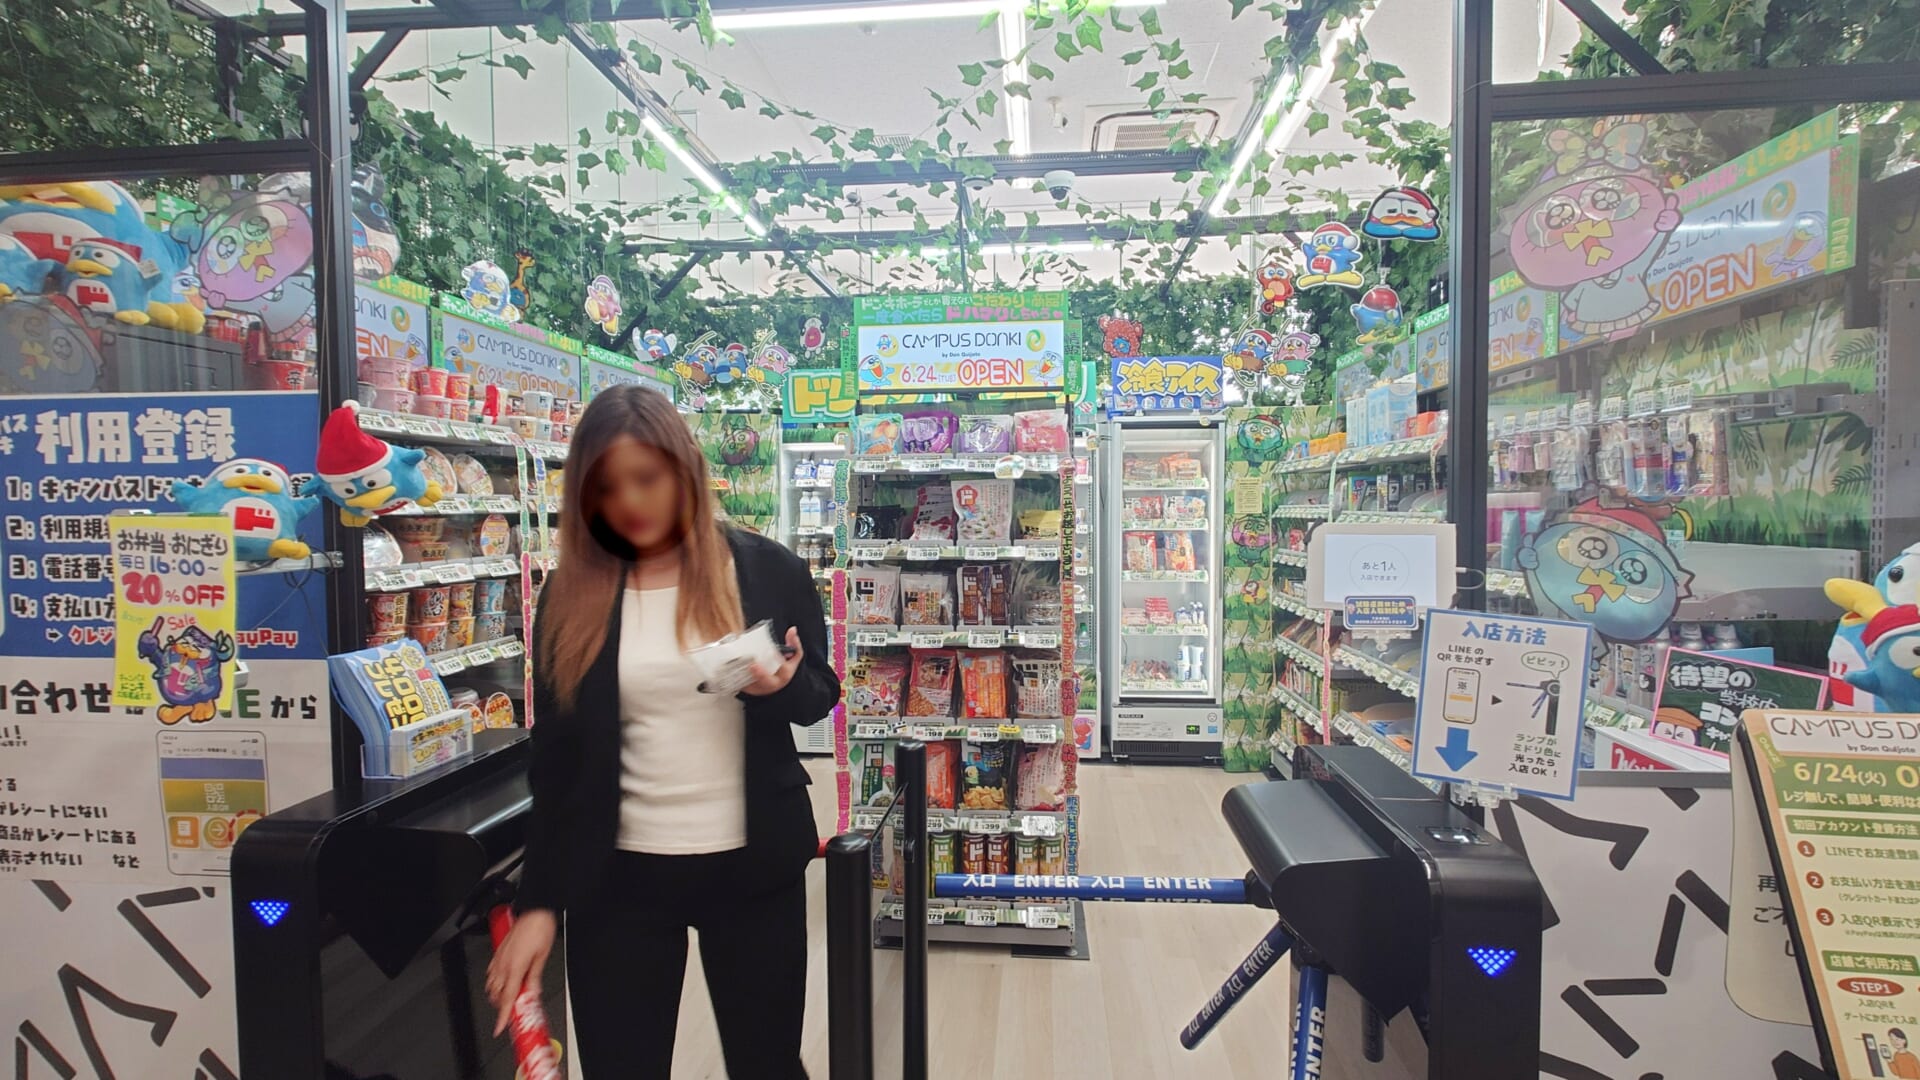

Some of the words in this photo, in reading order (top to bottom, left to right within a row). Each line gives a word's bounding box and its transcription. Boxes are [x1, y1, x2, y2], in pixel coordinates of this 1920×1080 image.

[1664, 243, 1756, 310] OPEN
[477, 333, 526, 361] CAMPUS
[902, 332, 971, 350] CAMPUS
[974, 331, 1021, 348] DONKI
[901, 363, 937, 385] 6.24
[958, 358, 1024, 388] OPEN
[35, 407, 236, 463] 利用登録
[1361, 560, 1397, 571] あと1人
[167, 615, 196, 631] Sale
[236, 628, 297, 646] ayPay
[1462, 620, 1547, 646] 入店方法
[1448, 645, 1472, 654] LINE
[1437, 652, 1452, 662] QR
[1454, 654, 1494, 666] をかざす
[1669, 664, 1752, 689] 待望の
[271, 695, 317, 720] から
[1770, 717, 1893, 739] CAMPUS
[1516, 733, 1558, 747] ランプが
[1847, 744, 1858, 753] by
[1860, 744, 1879, 752] Don
[1881, 745, 1916, 754] Quijote
[1513, 743, 1562, 759] ミドリ色に
[1515, 754, 1556, 768] 光ったら
[1793, 819, 1919, 836] 初回アカウント登録方法
[963, 873, 997, 888] 入口
[1014, 874, 1080, 889] ENTER
[1092, 875, 1125, 889] 入口
[1143, 876, 1213, 891] ENTER
[1242, 940, 1275, 978] ENTER
[1830, 955, 1914, 973] 店舗ご利用方法
[1850, 980, 1891, 995] STEP1
